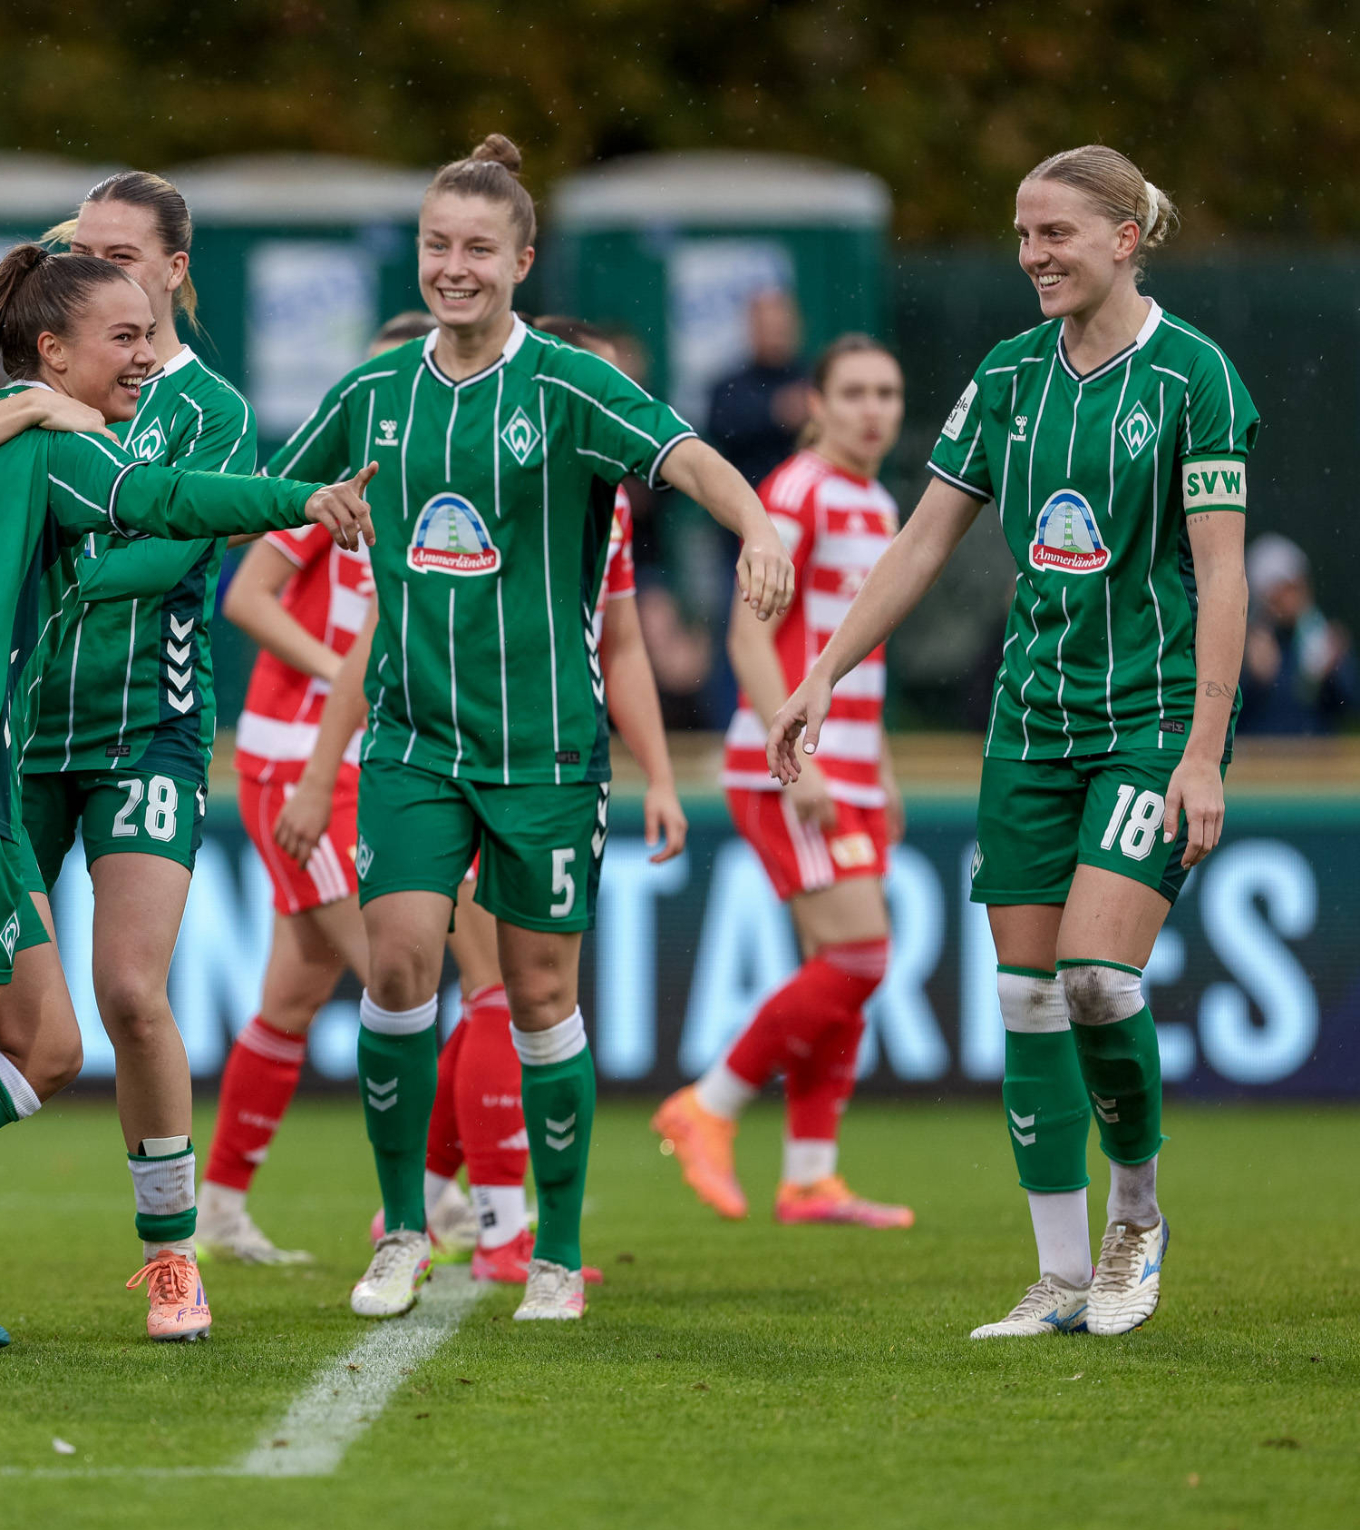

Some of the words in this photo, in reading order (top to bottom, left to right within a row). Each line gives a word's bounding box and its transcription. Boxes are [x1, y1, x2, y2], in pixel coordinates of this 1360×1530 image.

[1187, 470, 1241, 497] SVW
[413, 549, 495, 569] Ammerländer
[1034, 547, 1106, 568] Ammerländer
[112, 774, 179, 843] 28
[1100, 783, 1166, 862] 18
[550, 847, 576, 918] 5
